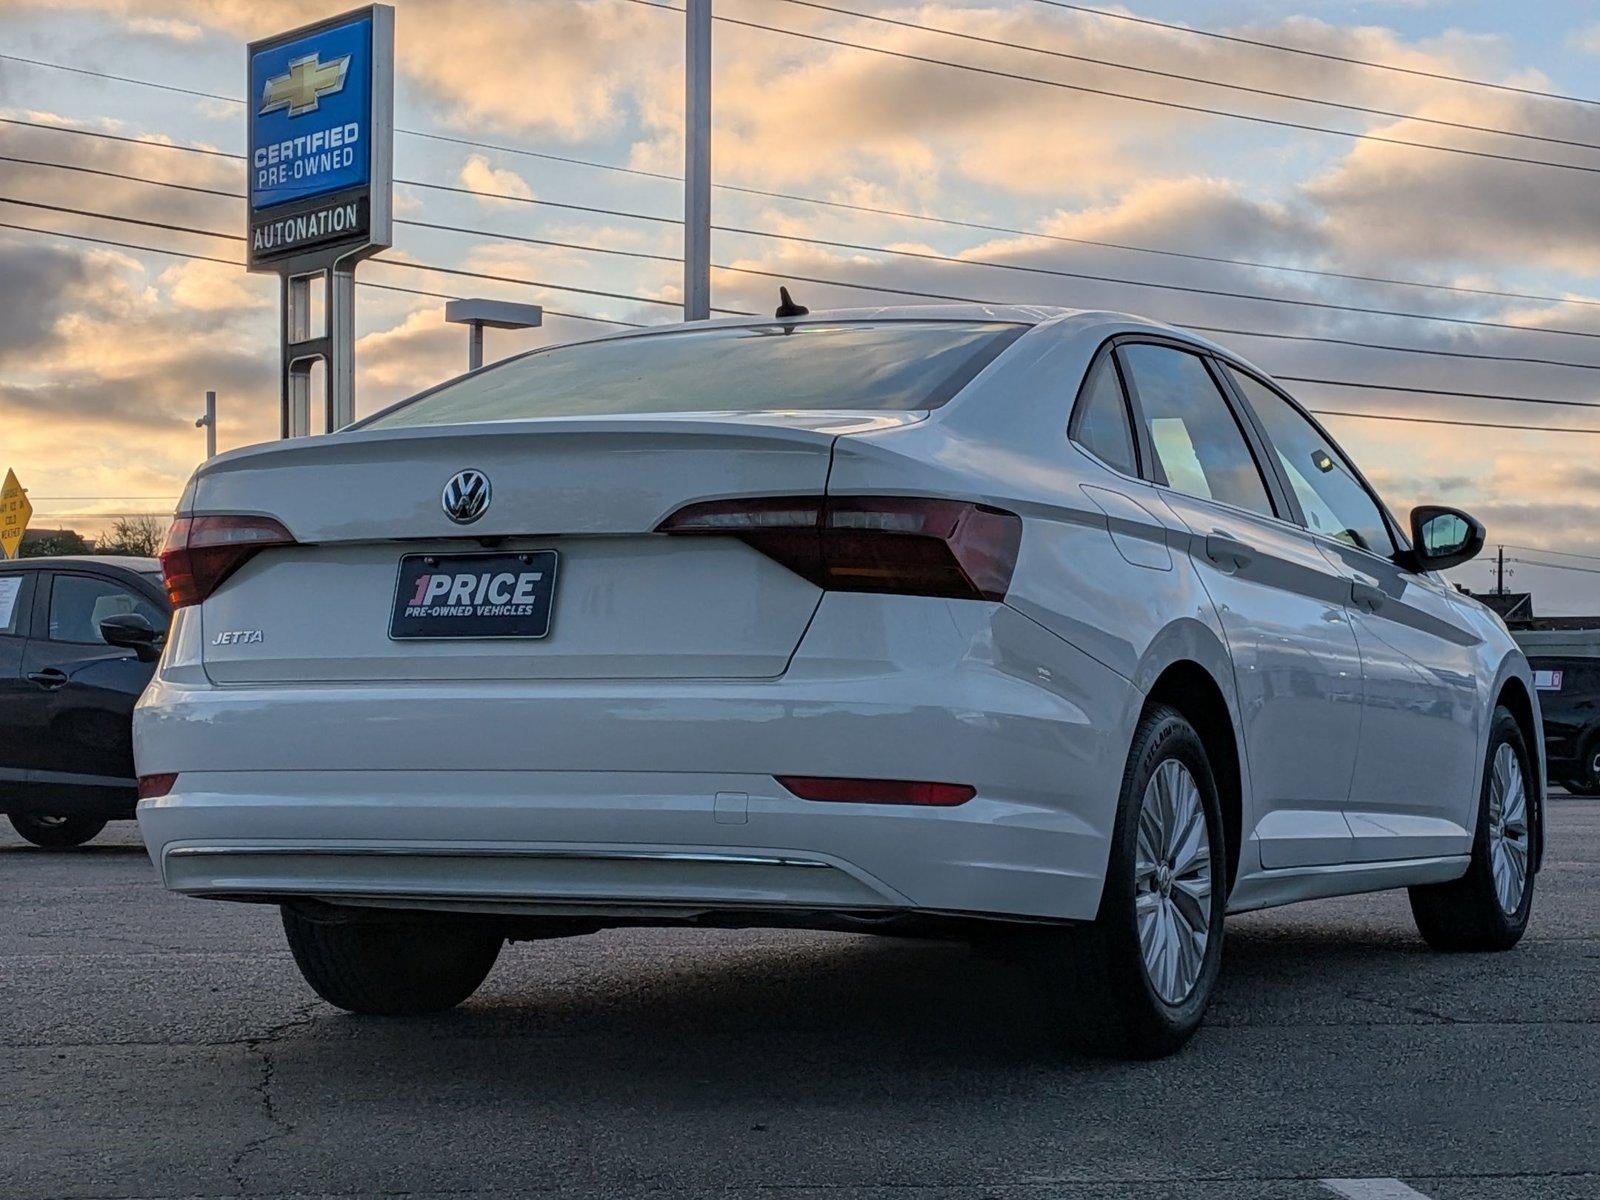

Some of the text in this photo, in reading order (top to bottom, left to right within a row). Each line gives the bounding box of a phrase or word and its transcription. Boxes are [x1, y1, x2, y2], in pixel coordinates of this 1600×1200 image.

[254, 122, 359, 168] CERTIFIED
[259, 147, 353, 189] PRE-OWNED
[253, 204, 357, 251] AUTONATION
[408, 572, 543, 606] 1PRICE
[404, 605, 534, 618] PRE-OWNED VEHICLES
[211, 630, 264, 645] JETTA
